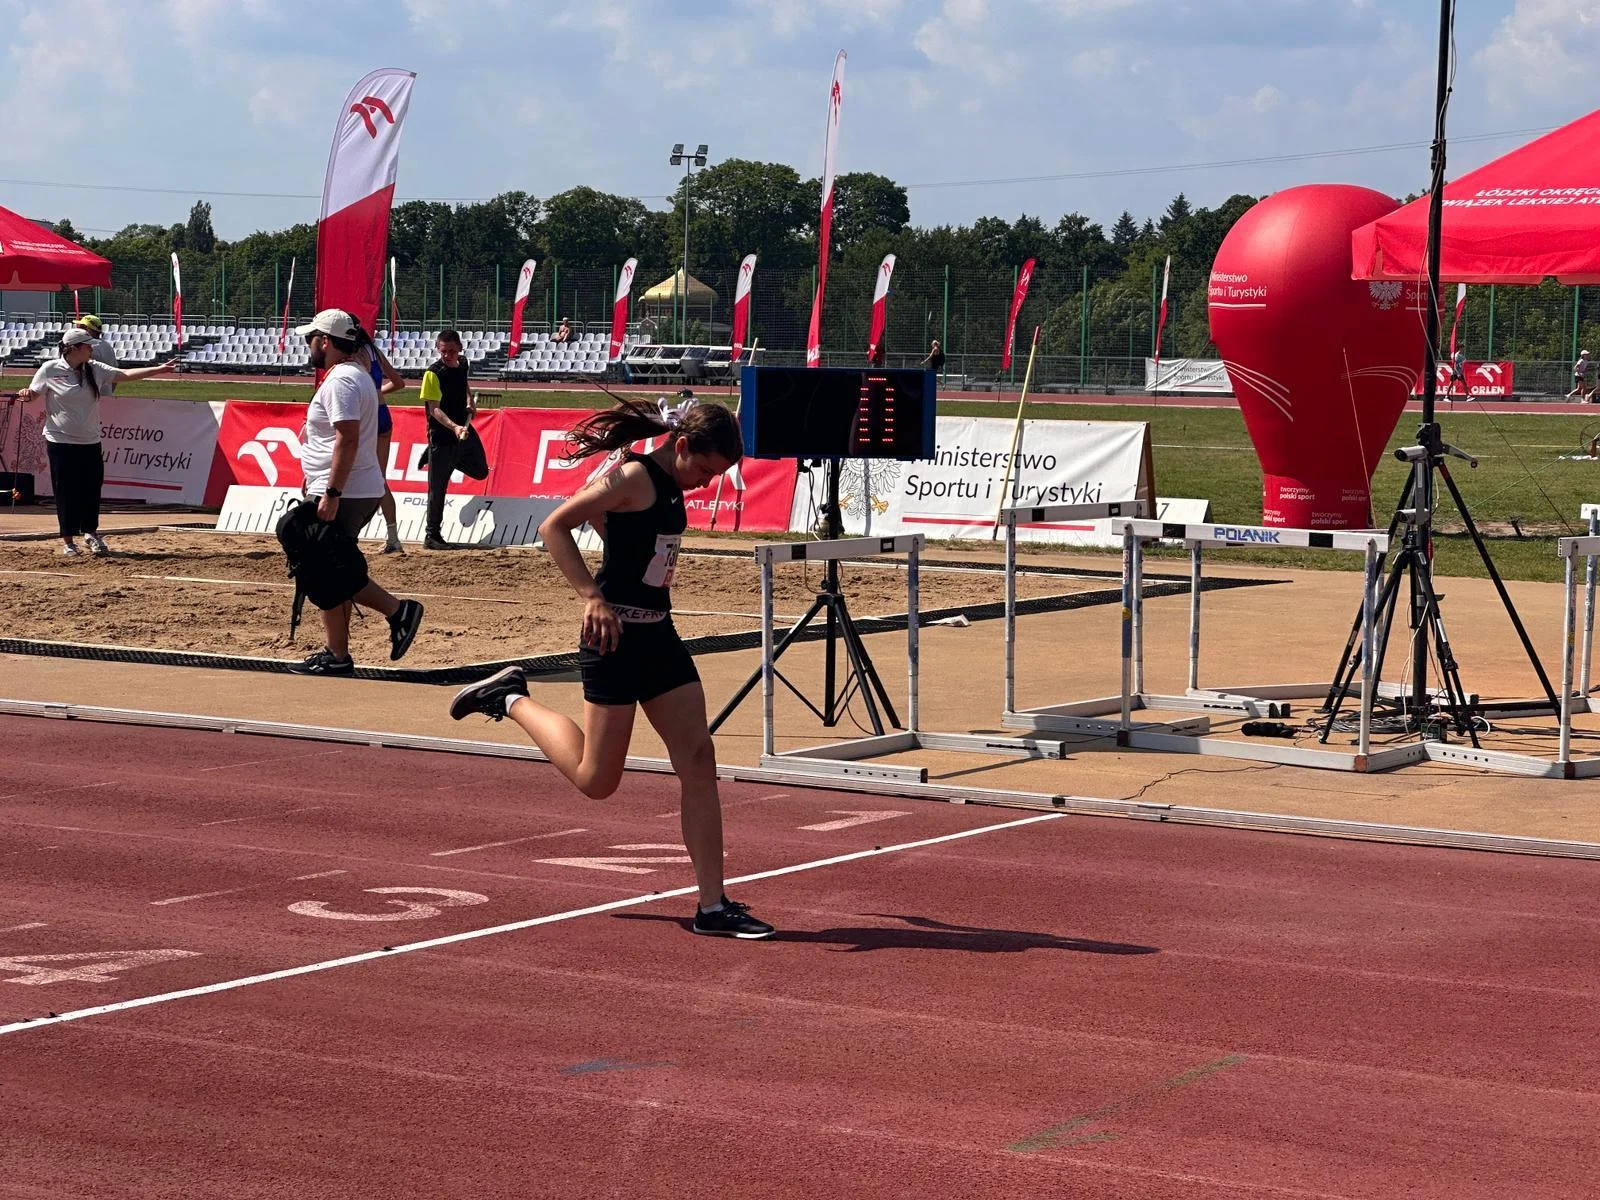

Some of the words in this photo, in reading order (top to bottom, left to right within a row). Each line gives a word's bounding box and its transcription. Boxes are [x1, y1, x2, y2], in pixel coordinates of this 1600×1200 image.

[1228, 286, 1267, 300] Turystyki
[1471, 385, 1505, 395] ORLEN
[100, 423, 164, 442] sterstwo
[124, 448, 193, 472] Turystyki
[911, 445, 1057, 470] inisterstwo
[905, 474, 979, 501] Sportu
[985, 477, 993, 499] i
[480, 500, 493, 521] 7
[684, 499, 745, 512] ATLETYKI
[1213, 526, 1281, 544] POLANIK
[286, 885, 490, 923] 3
[0, 947, 204, 987] 4
